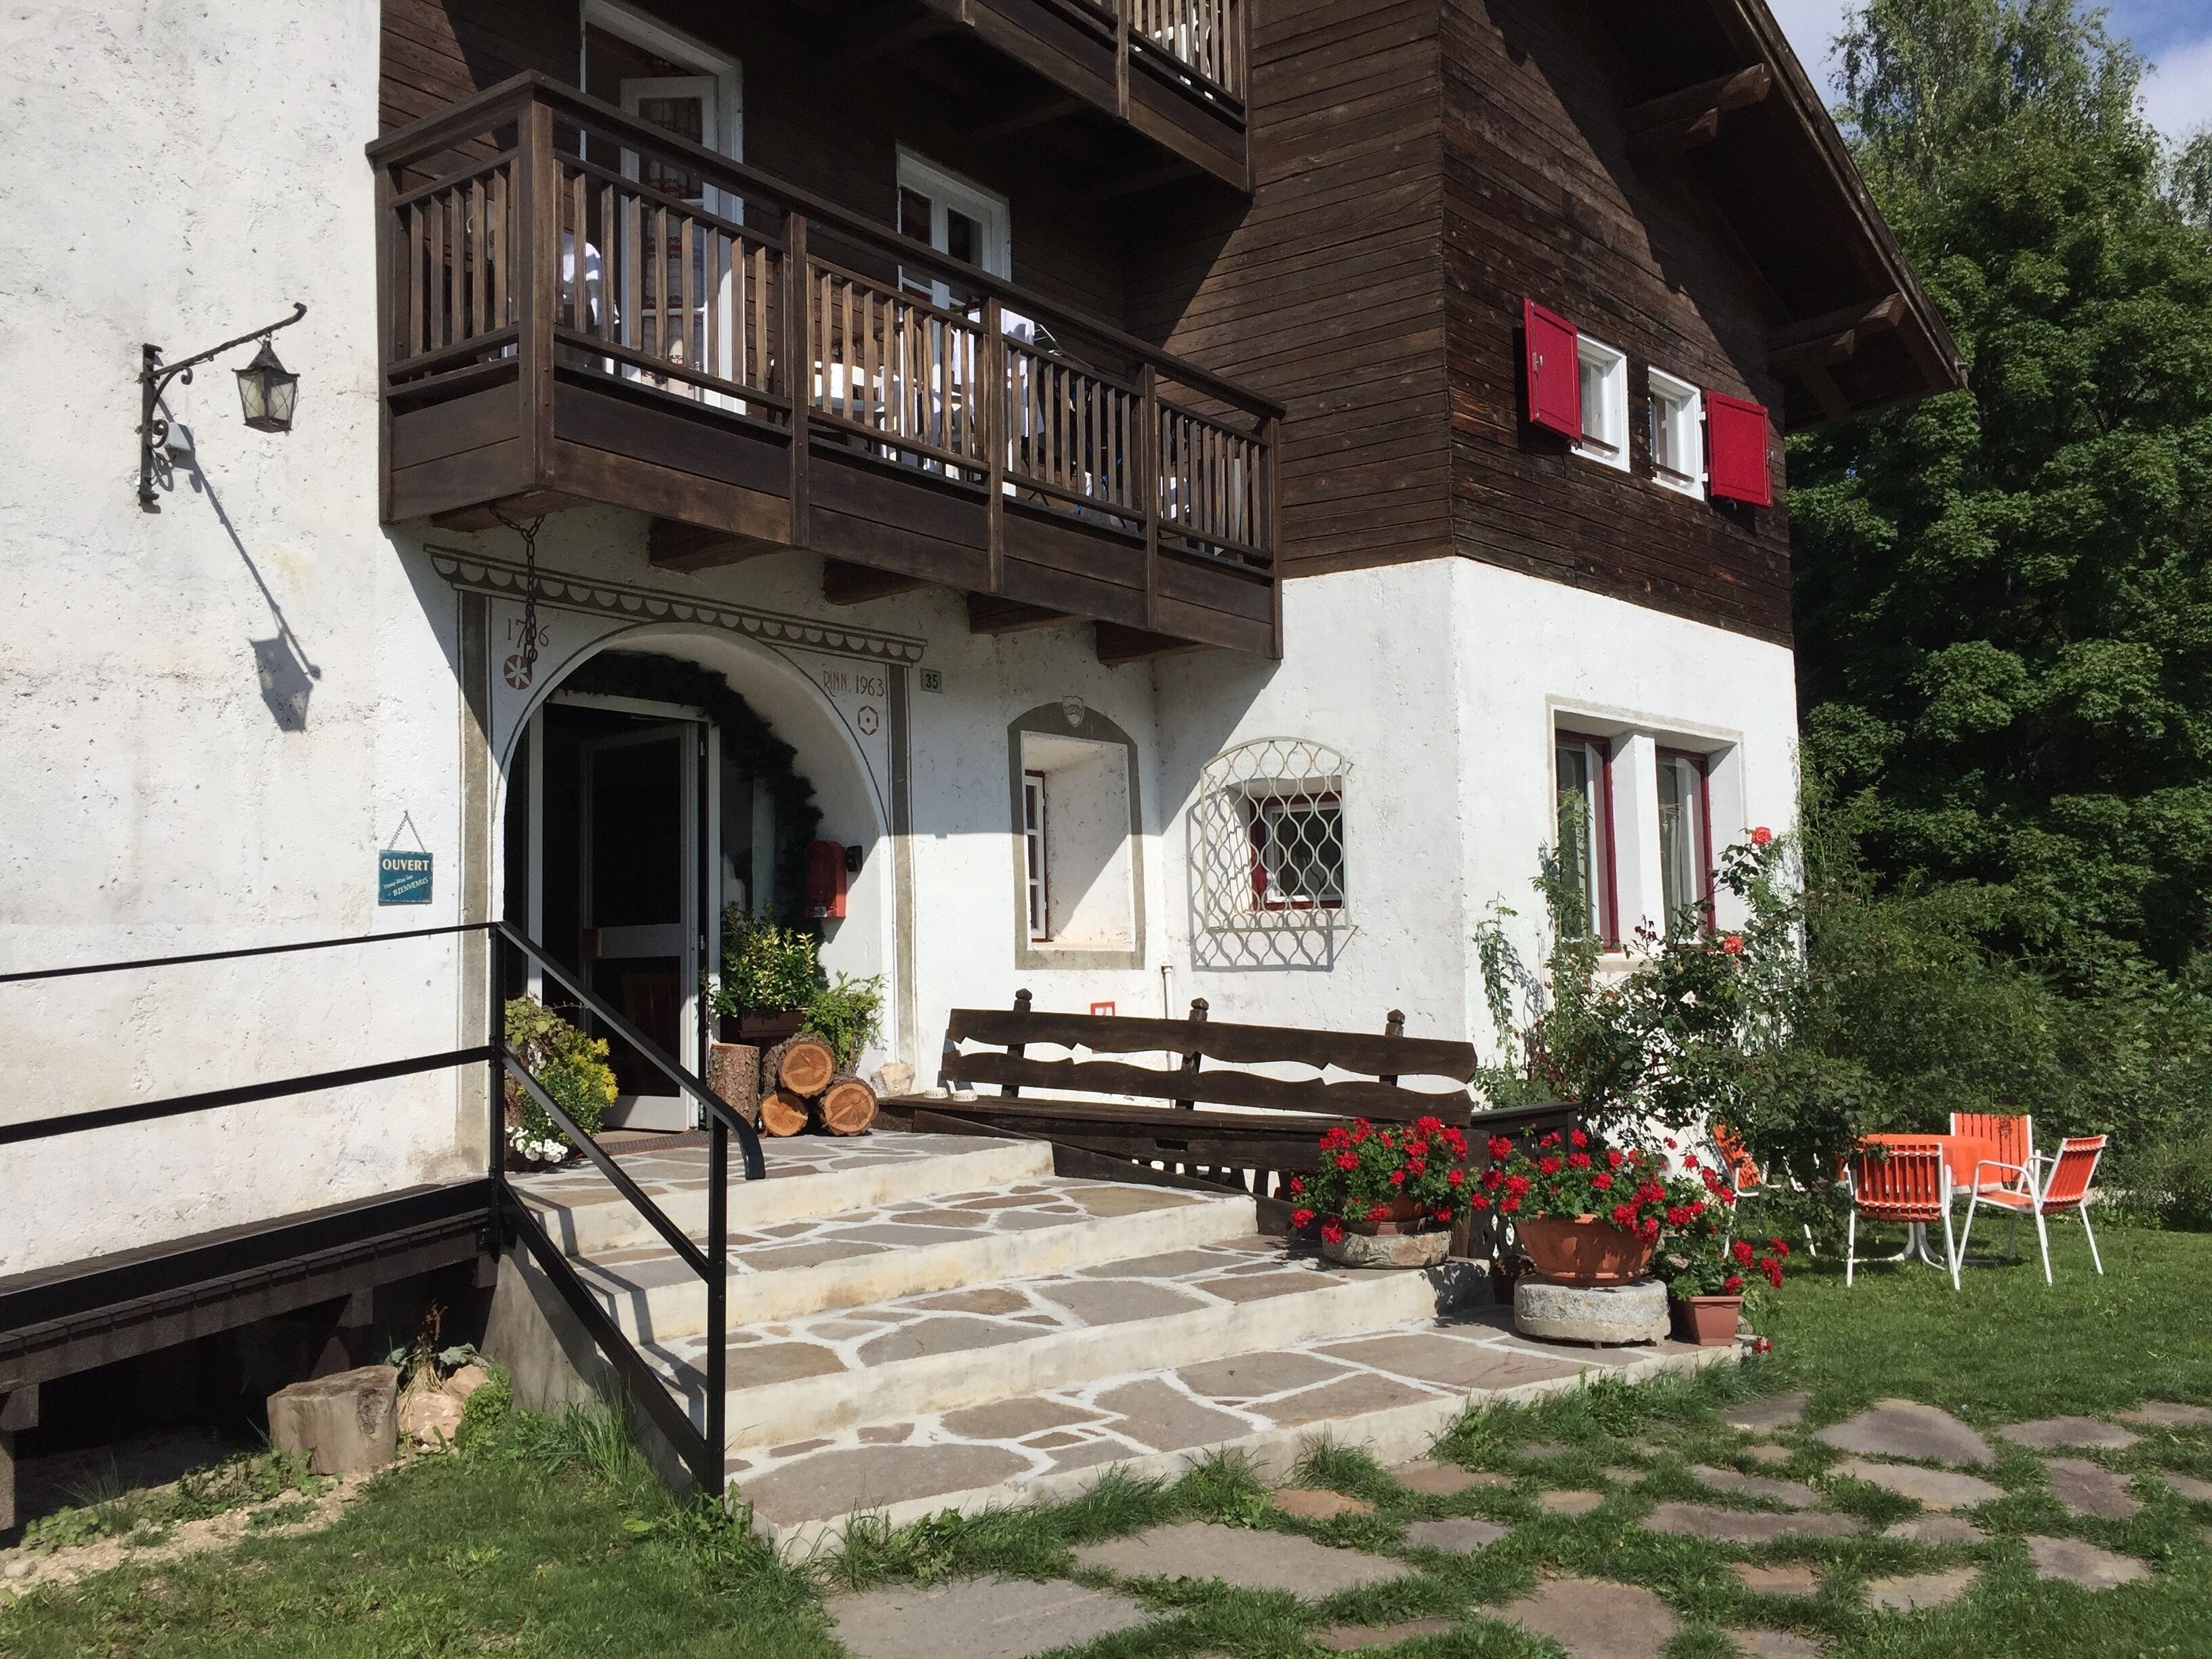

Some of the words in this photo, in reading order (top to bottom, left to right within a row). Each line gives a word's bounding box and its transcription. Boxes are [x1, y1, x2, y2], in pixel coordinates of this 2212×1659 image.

[508, 618, 550, 648] 176
[855, 675, 884, 697] 1963
[925, 673, 939, 689] 35
[382, 858, 430, 871] OUVERT
[392, 876, 429, 897] BIENVENUS
